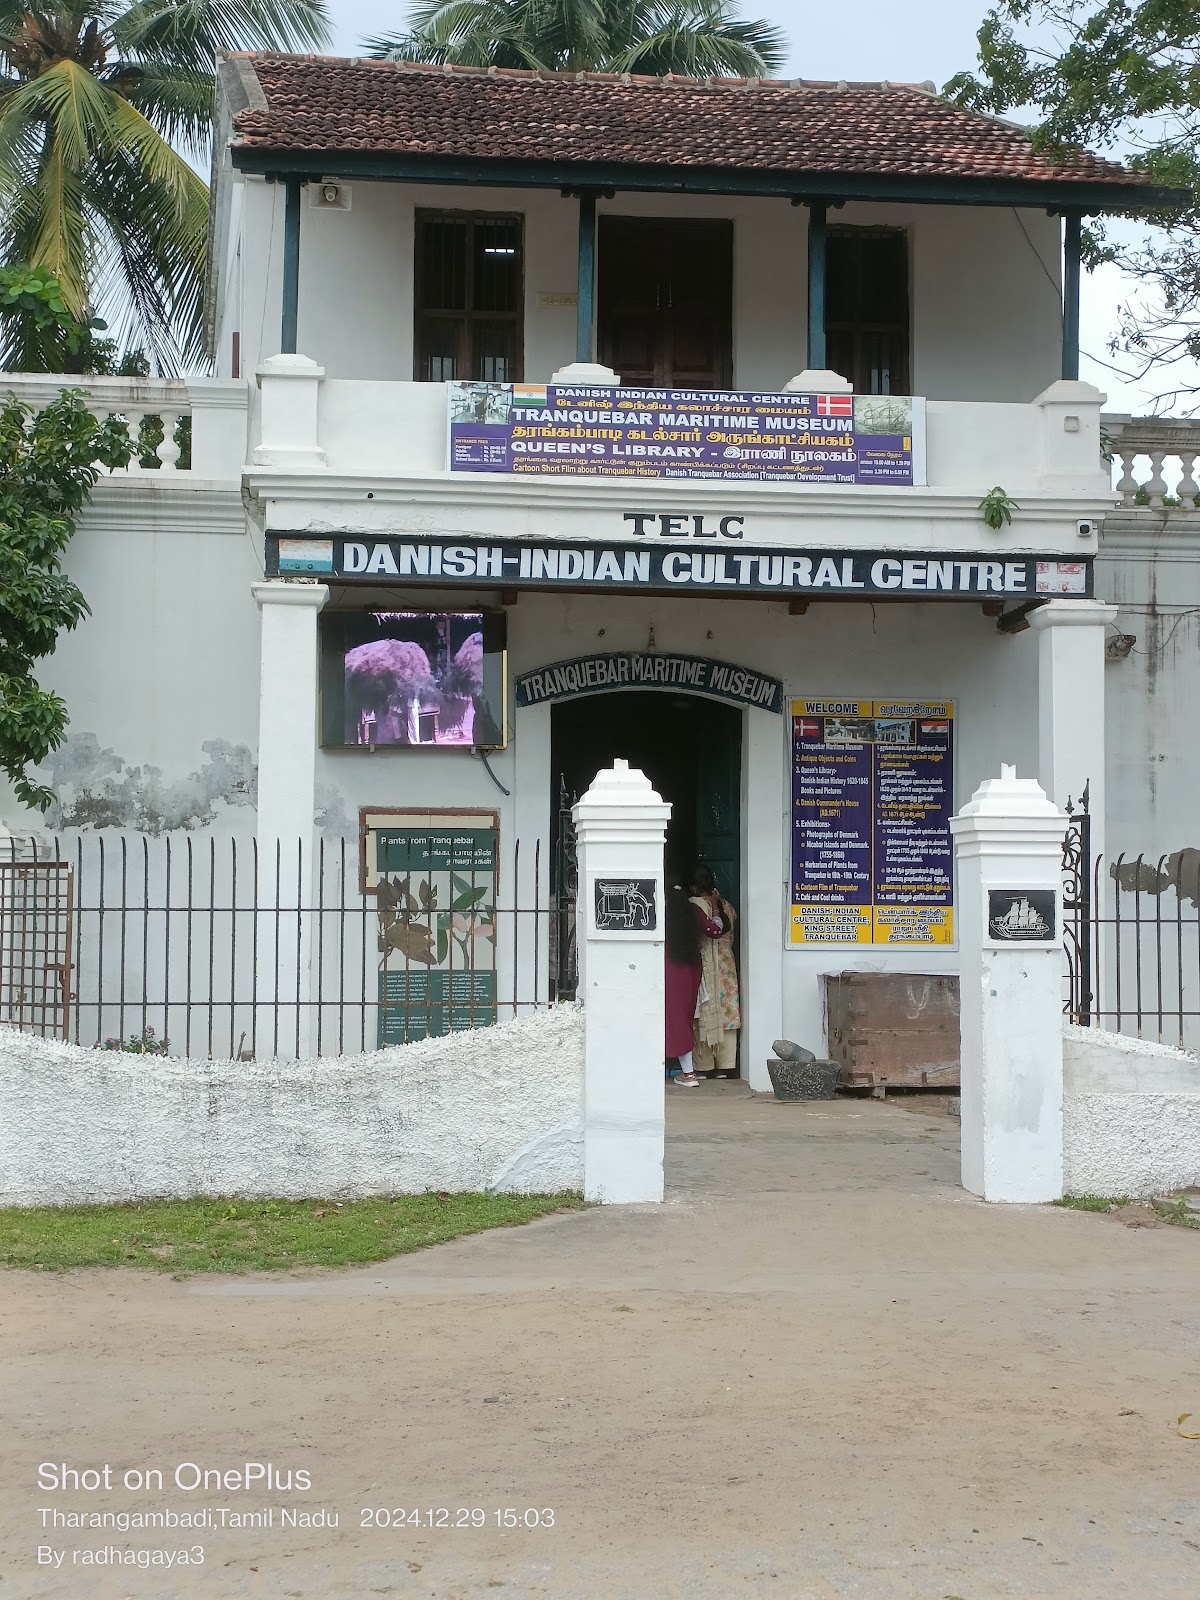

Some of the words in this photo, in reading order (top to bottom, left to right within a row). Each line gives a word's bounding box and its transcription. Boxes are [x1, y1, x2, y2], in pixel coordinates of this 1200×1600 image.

[556, 388, 611, 398] DANISH
[615, 390, 666, 399] INDIAN
[670, 393, 748, 403] CULTURAL
[752, 396, 810, 405] CENTRE
[556, 399, 613, 409] டேனிஷ்
[617, 401, 672, 411] இந்திய
[676, 404, 751, 414] கலாச்சார
[755, 406, 811, 414] மையம்
[512, 408, 653, 425] TRANQUEBAR
[659, 414, 759, 428] MARITIME
[766, 417, 853, 431] MUSEUM
[511, 423, 623, 441] தரங்கம்பாடி
[627, 426, 702, 442] கடல்சார்
[706, 430, 854, 446] அருங்காட்சியகம்
[511, 441, 605, 454] QUEEN'S
[612, 444, 705, 457] LIBRARY
[723, 446, 786, 460] இராணி
[791, 448, 857, 464] நூலகம்
[513, 463, 540, 472] Cartoon
[542, 464, 560, 472] Short
[561, 465, 576, 473] Film
[577, 465, 596, 474] about
[598, 466, 635, 476] Tranquebar
[636, 467, 661, 477] History
[666, 468, 687, 477] Danish
[688, 469, 722, 480] Tranquebar
[723, 470, 759, 479] Association
[797, 472, 836, 482] Development
[623, 513, 745, 538] TELC
[343, 542, 651, 582] DANISH-INDIAN
[661, 551, 867, 588] CULTURAL
[870, 558, 1027, 592] CENTRE
[521, 657, 629, 702] TRANQUEBAR
[632, 657, 707, 686] MARITIME
[710, 665, 776, 706] MUSEUM
[805, 702, 859, 715] WELCOME
[801, 742, 825, 751] Tranquebar
[801, 755, 817, 763] Antique
[818, 755, 835, 763] Objects
[801, 766, 818, 774] Queen's
[801, 776, 816, 784] Danish
[830, 777, 846, 786] History
[801, 786, 814, 794] Books
[381, 837, 406, 845] Pants
[806, 830, 833, 839] Photographs
[806, 840, 823, 848] Nicobar
[804, 871, 826, 880] Tranquebar
[853, 872, 869, 880] Century
[834, 884, 858, 892] Tranquebar
[811, 893, 820, 901] and
